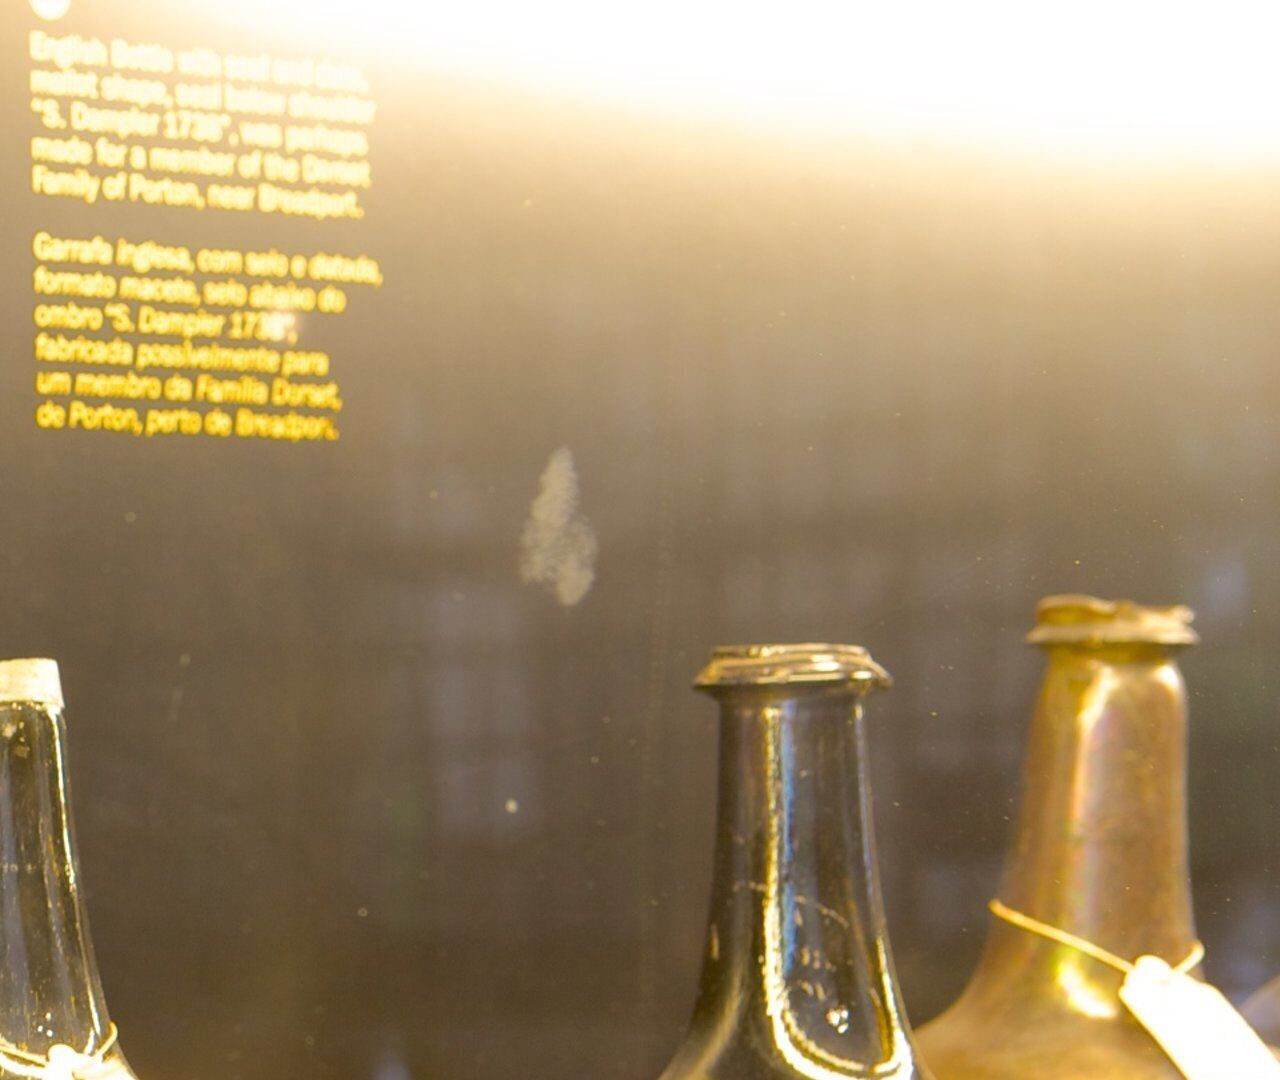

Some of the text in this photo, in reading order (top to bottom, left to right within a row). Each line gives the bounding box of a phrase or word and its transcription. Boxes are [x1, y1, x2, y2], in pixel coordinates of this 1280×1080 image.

[96, 137, 127, 167] for
[130, 145, 147, 169] a
[237, 149, 263, 179] of
[32, 165, 100, 204] Family
[102, 171, 128, 200] of
[196, 248, 243, 275] com
[290, 254, 308, 279] e
[34, 265, 117, 299] formato
[34, 302, 103, 331] ombro
[34, 332, 133, 365] fabricada
[281, 350, 330, 377] para
[36, 372, 72, 395] um
[74, 370, 162, 400] membro
[163, 372, 193, 401] da
[36, 399, 66, 428] de
[68, 400, 142, 437] Porton,
[144, 407, 202, 438] perto
[204, 408, 232, 437] de
